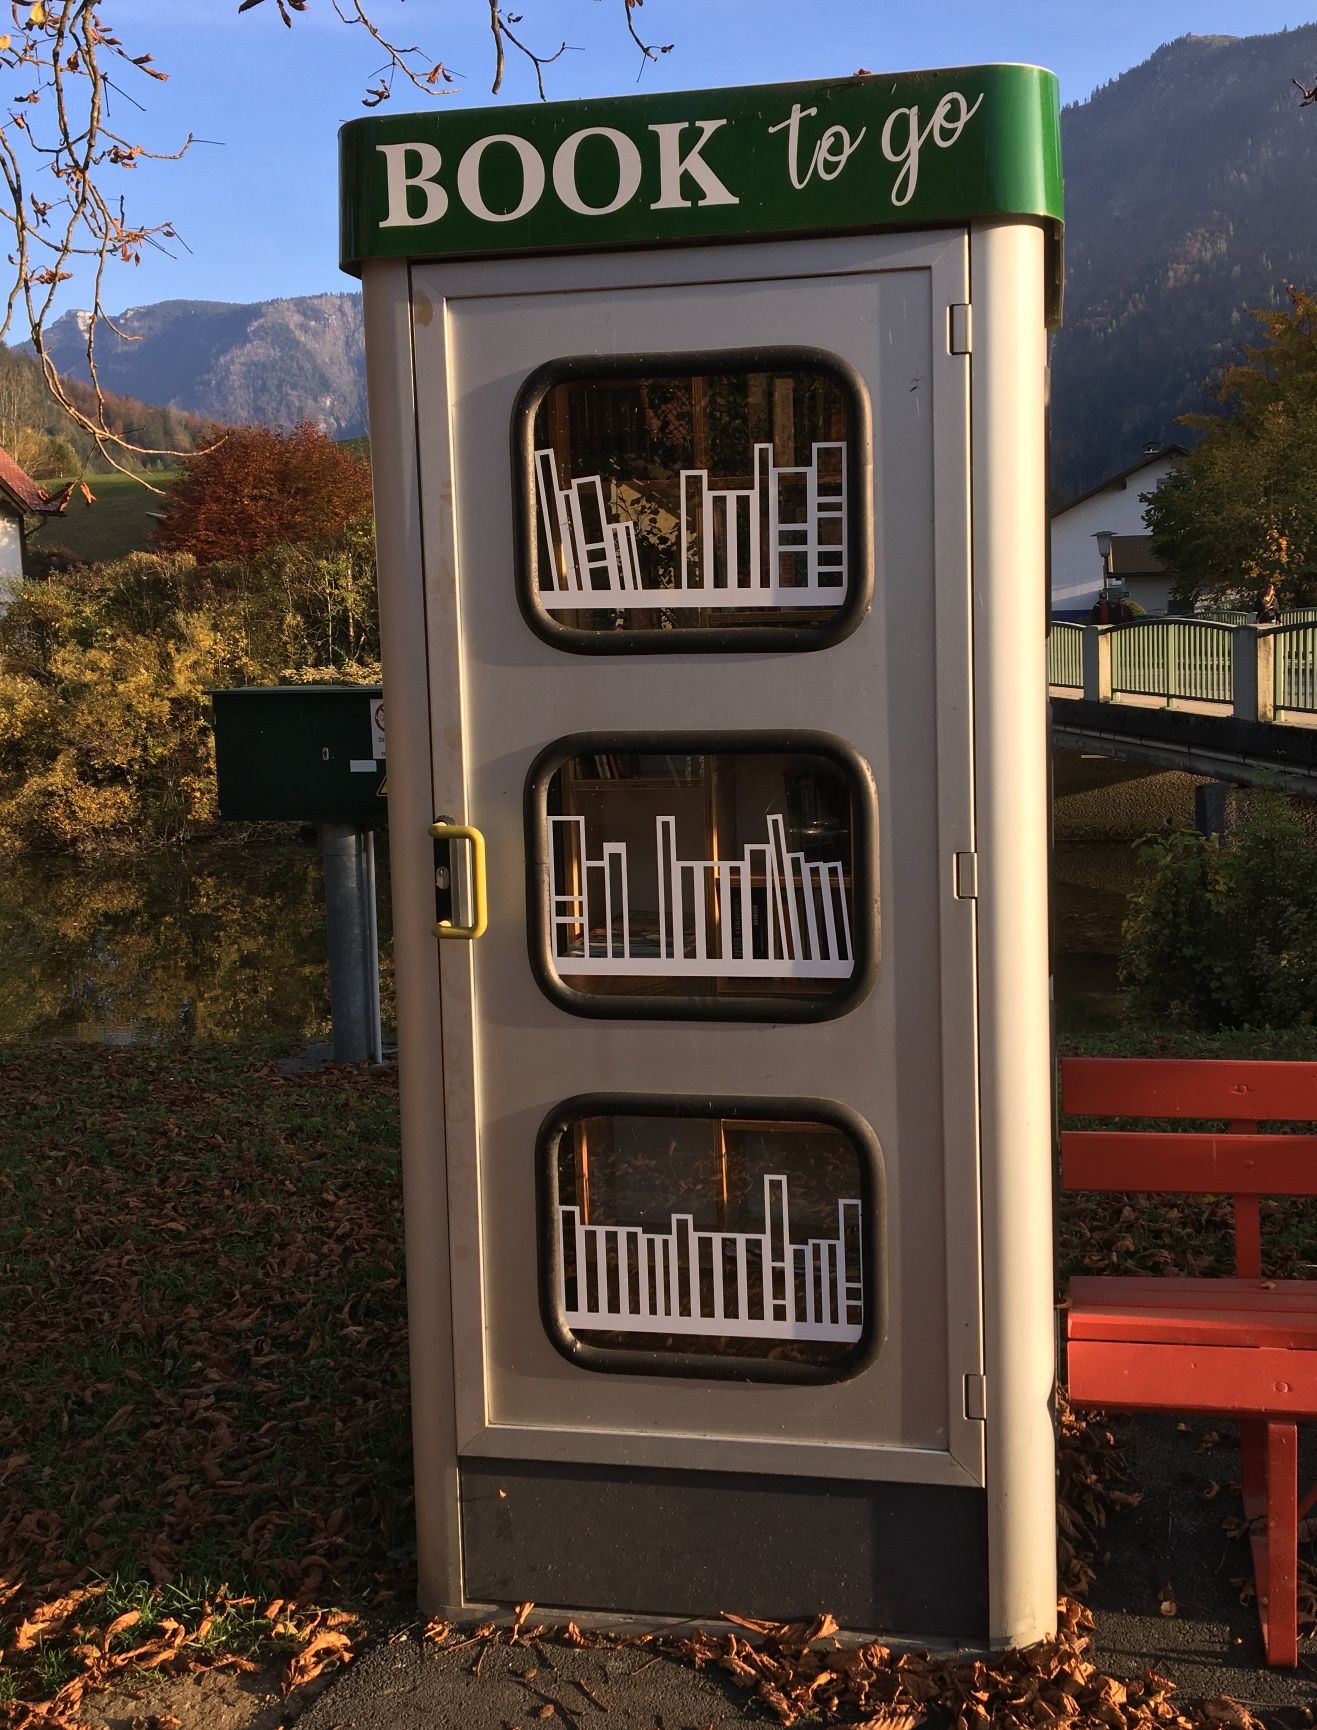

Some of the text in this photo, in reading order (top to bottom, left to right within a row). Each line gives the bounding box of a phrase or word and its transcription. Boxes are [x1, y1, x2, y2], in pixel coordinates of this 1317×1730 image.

[376, 91, 984, 228] BOOK to go
